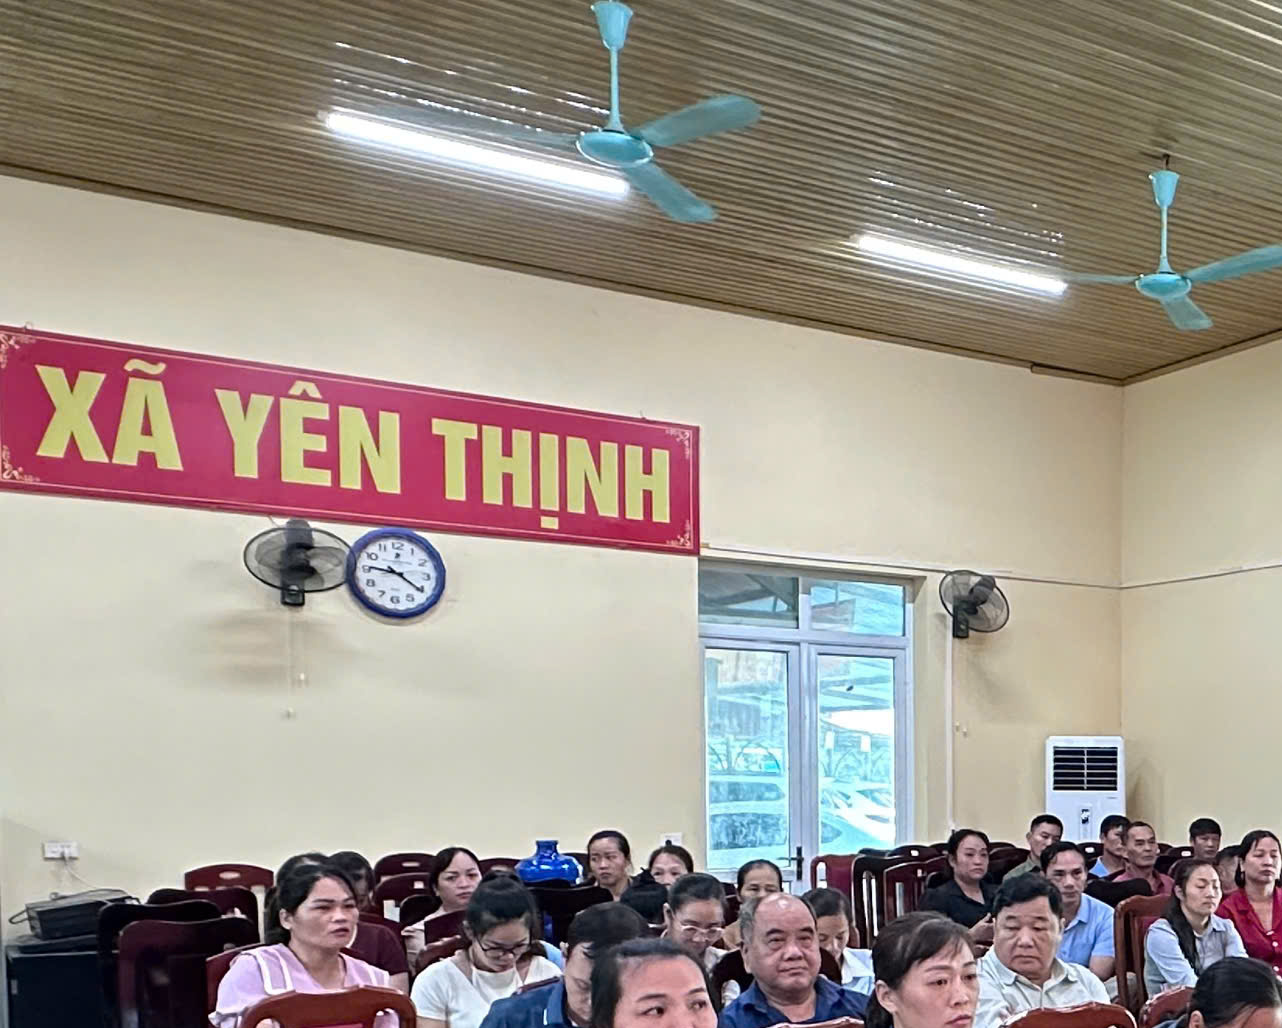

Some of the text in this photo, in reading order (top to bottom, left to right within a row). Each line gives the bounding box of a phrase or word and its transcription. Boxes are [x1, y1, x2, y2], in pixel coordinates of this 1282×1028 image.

[34, 359, 671, 529] XÃ YÊN THỊNH
[391, 542, 405, 550] 12
[365, 552, 379, 561] 10
